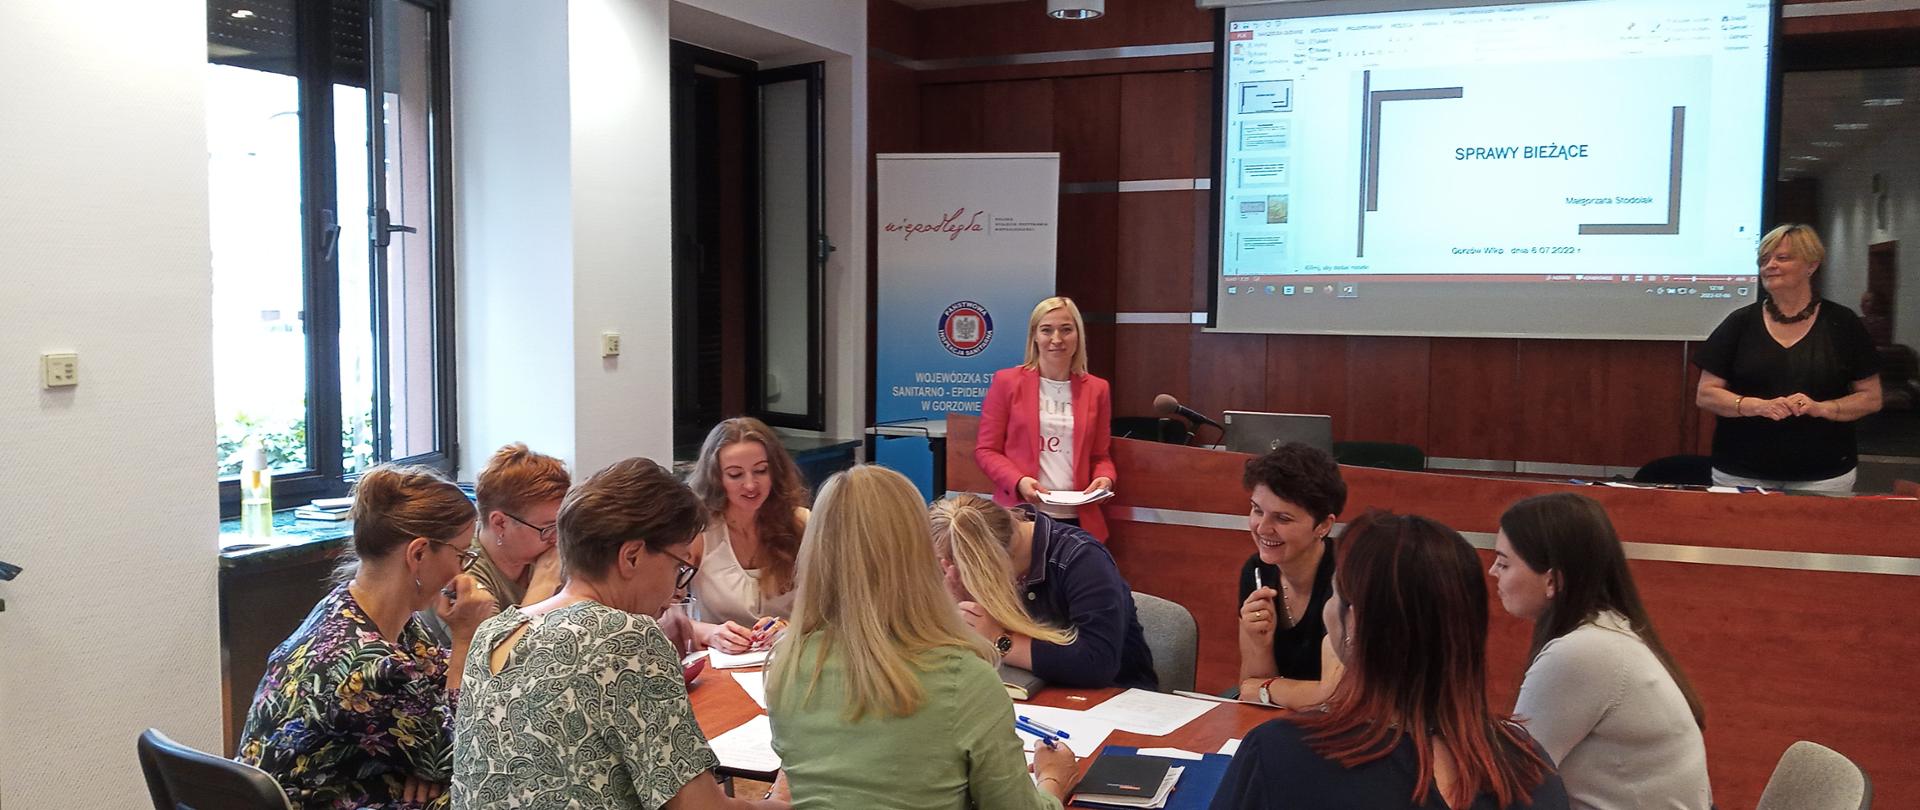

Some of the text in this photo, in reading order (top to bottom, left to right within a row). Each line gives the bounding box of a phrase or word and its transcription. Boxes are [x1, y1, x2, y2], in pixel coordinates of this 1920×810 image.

[1455, 142, 1589, 160] SPRAWY BIEŻĄCE
[915, 370, 981, 384] WOJEWÓDZKA
[892, 386, 945, 397] SANITARNO
[951, 387, 991, 398] EPIDEM
[921, 401, 982, 412] W GORZOWIE
